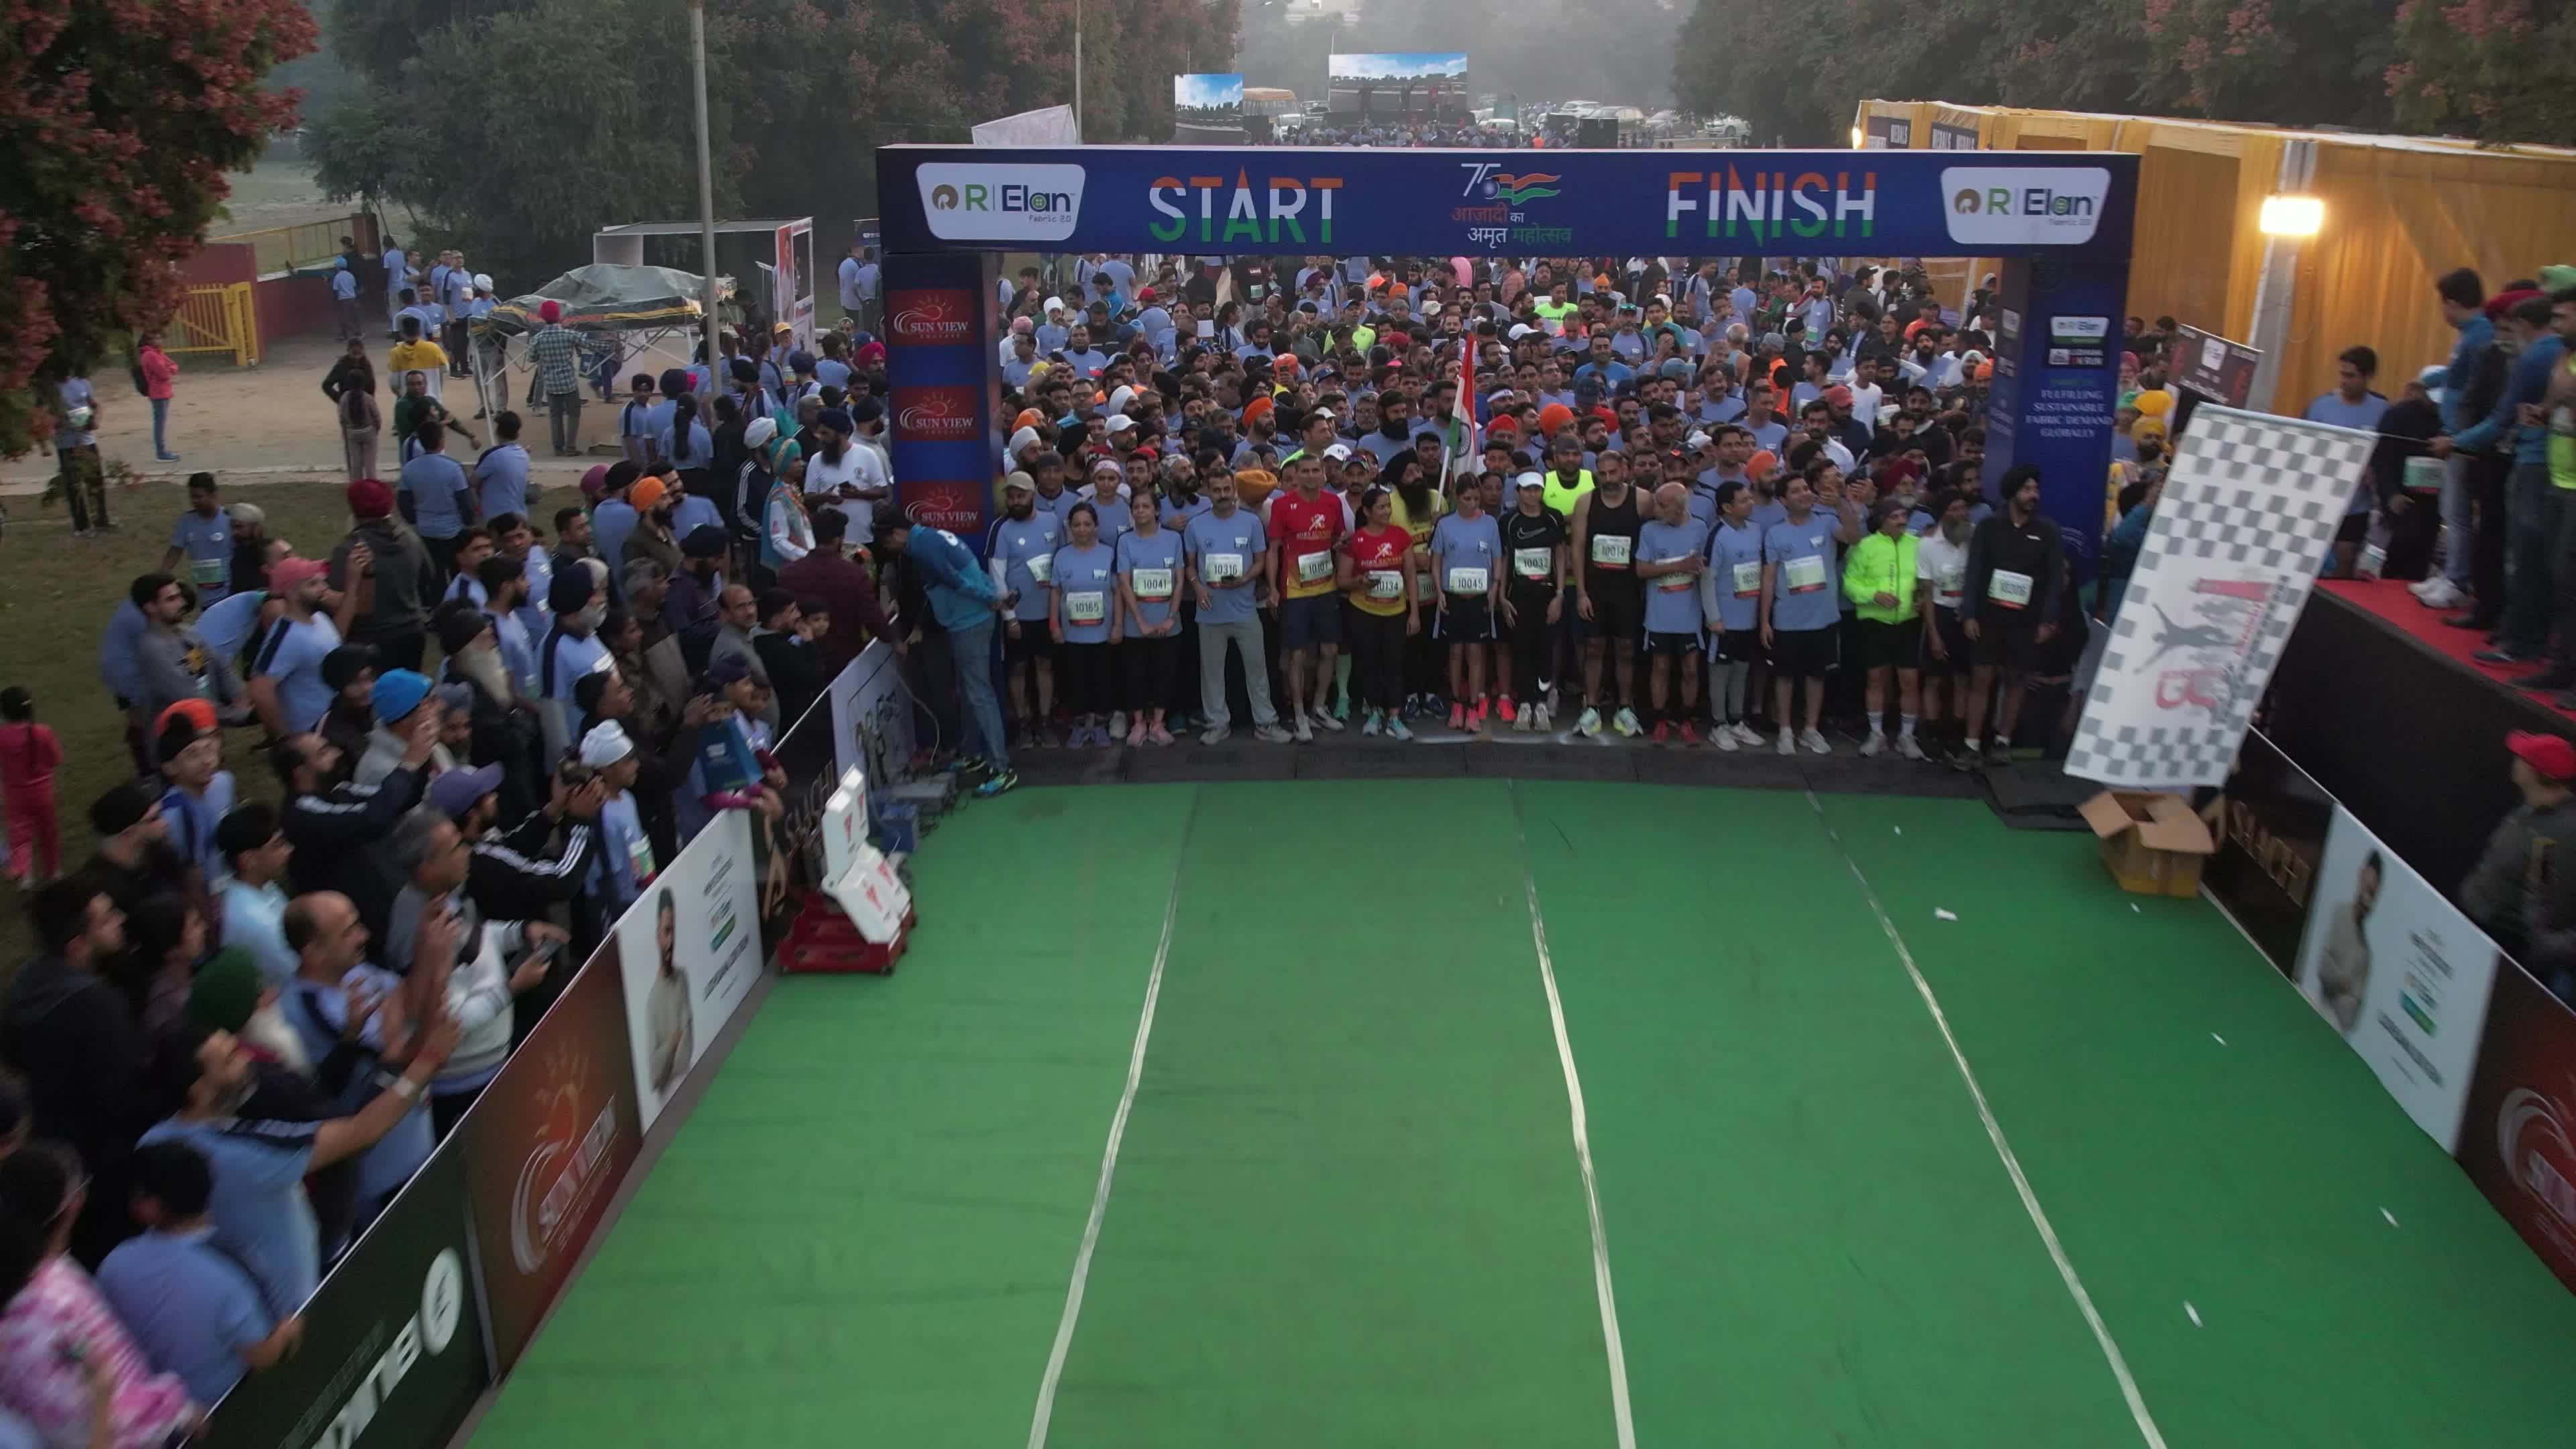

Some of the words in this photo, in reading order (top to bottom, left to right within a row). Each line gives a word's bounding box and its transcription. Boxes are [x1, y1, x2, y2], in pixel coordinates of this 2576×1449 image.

[1148, 165, 1344, 244] START
[1666, 162, 1877, 247] FINISH
[1028, 215, 1057, 223] Fabric
[1510, 212, 1524, 223] का
[1468, 227, 1508, 249] अमृत
[910, 321, 935, 332] SUN
[936, 321, 968, 331] VIEW
[916, 417, 940, 428] SUN
[941, 417, 973, 427] VIEW
[921, 511, 945, 522] SUN
[947, 511, 978, 521] VIEW
[1214, 564, 1238, 575] 10316
[1143, 579, 1167, 590] 10041
[1458, 578, 1483, 589] 10045
[1075, 602, 1099, 613] 10165
